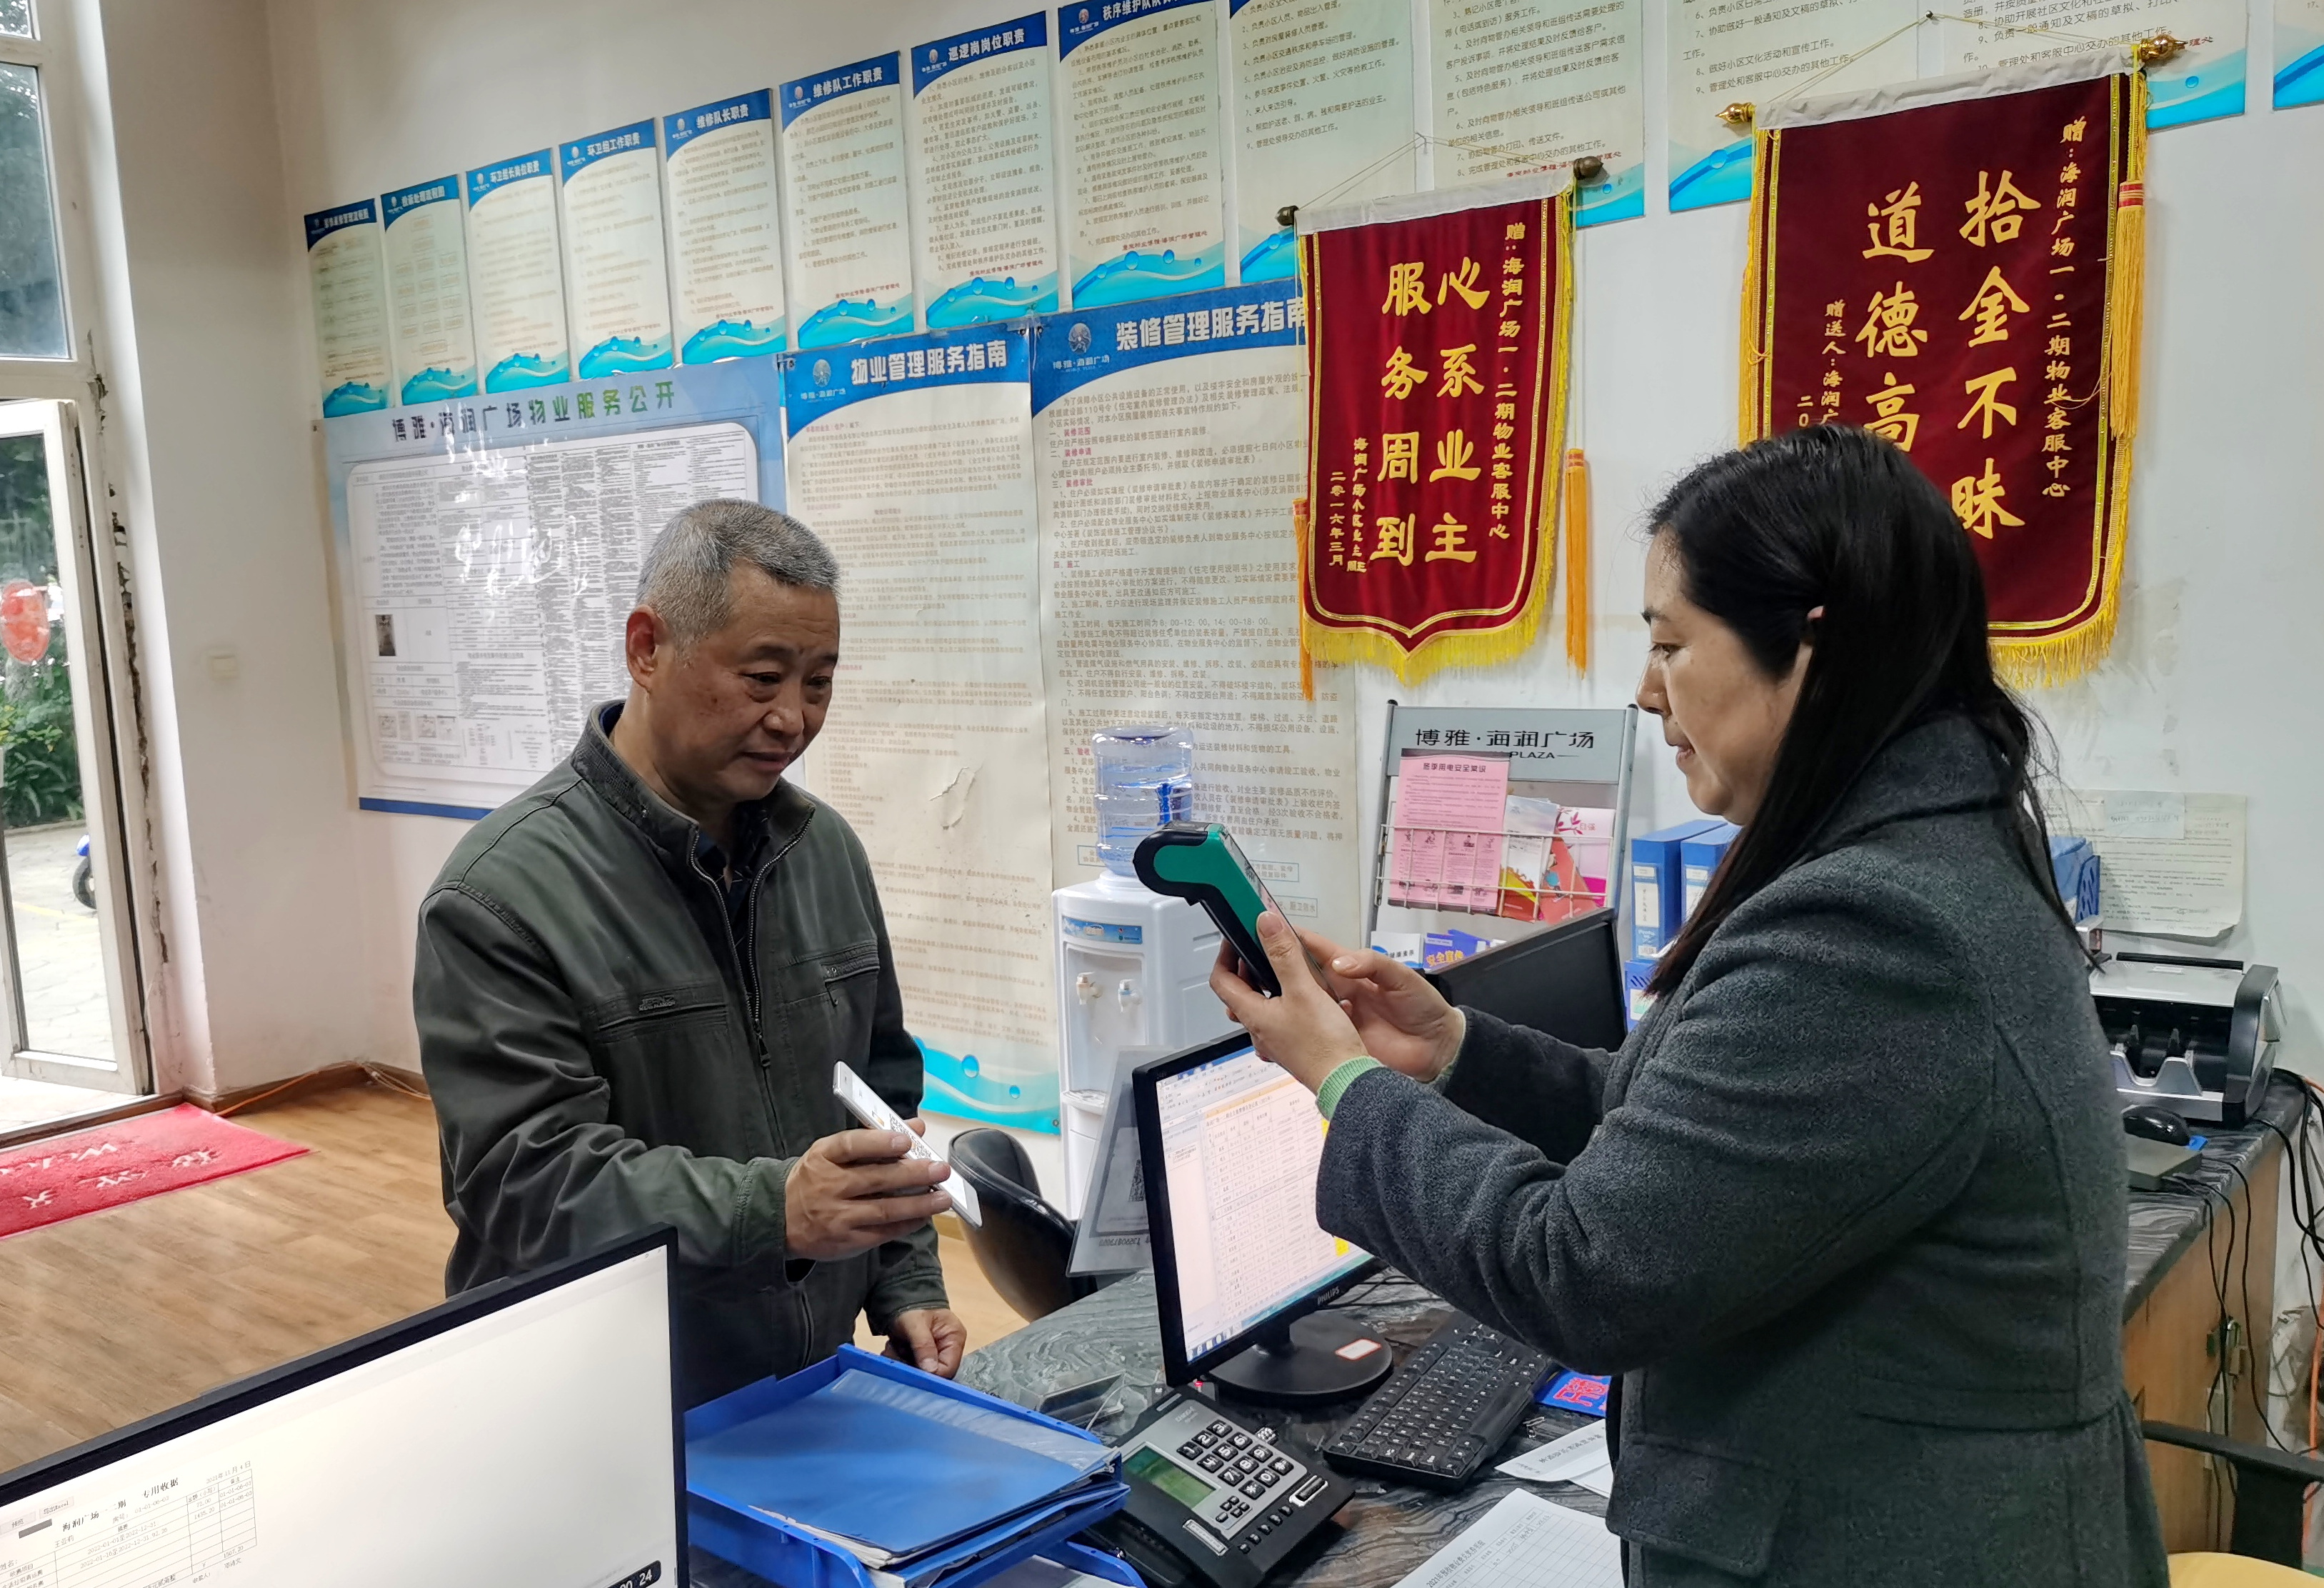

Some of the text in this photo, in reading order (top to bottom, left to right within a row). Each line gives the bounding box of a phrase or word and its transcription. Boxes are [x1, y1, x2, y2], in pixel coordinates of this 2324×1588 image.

[948, 28, 1025, 62] 巡逻岗岗位职责
[1683, 49, 1706, 61] 工作。
[1963, 52, 1979, 62] 作。
[813, 67, 883, 98] 维修队工作职责
[696, 104, 748, 130] 维修队长职责
[1116, 298, 1306, 351] 装修管理服务指南
[1951, 171, 2040, 539] 拾金不昧
[851, 341, 1007, 385] 物业管理服务指南
[1053, 354, 1110, 369] 博雅·海润广场
[1370, 262, 1431, 566] 服务周到
[1425, 256, 1491, 562] 心系业主
[1049, 426, 1091, 438] 一、装修范围
[1050, 447, 1091, 459] 二、装修申请
[1052, 478, 1093, 489] 三、装修审批
[1416, 729, 1594, 749] 博雅·海润广场
[1423, 762, 1486, 773] 冬季用电安全常识
[1317, 1286, 1340, 1307] PHILIPS
[1213, 1424, 1224, 1433] 3
[1198, 1434, 1209, 1444] 2
[1234, 1436, 1245, 1445] 6
[1219, 1446, 1231, 1457] 5
[1253, 1449, 1266, 1459] 9
[1240, 1459, 1251, 1469] 8
[1224, 1471, 1235, 1481] 7
[1261, 1473, 1271, 1482] 0
[638, 1569, 653, 1582] 24
